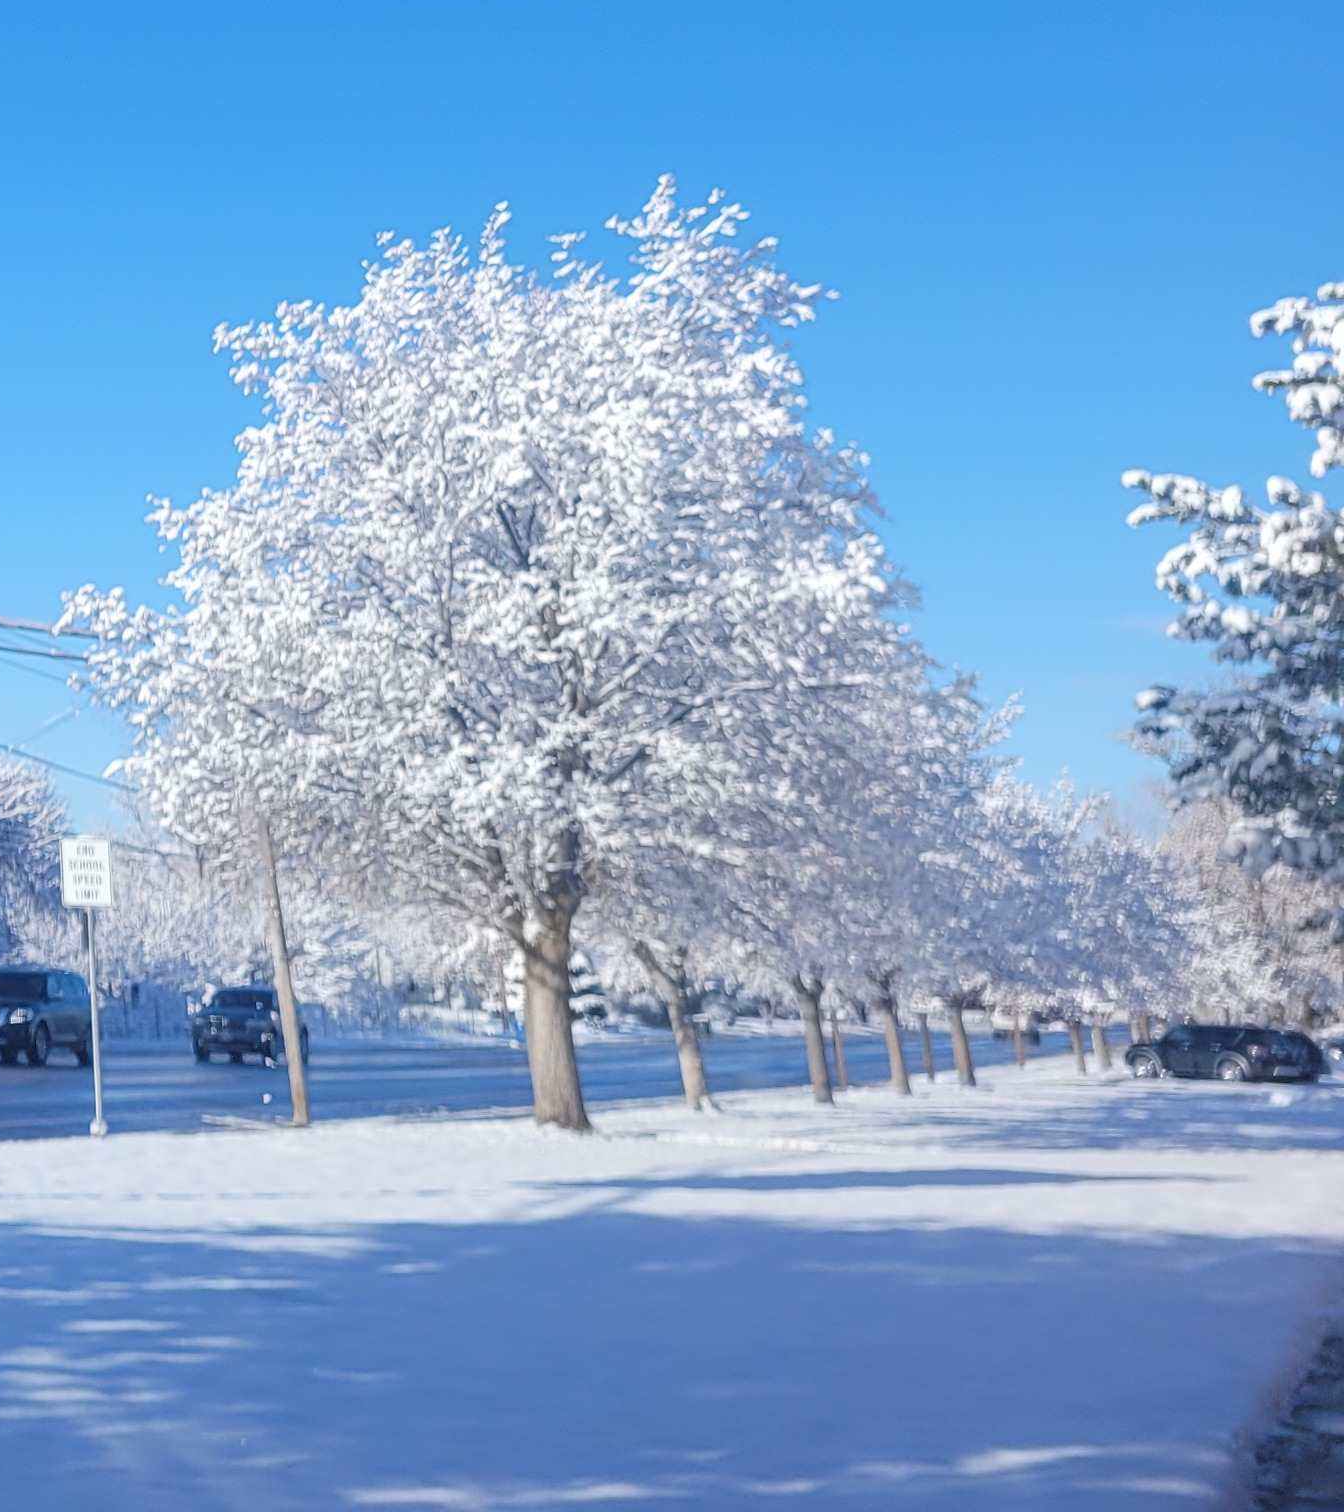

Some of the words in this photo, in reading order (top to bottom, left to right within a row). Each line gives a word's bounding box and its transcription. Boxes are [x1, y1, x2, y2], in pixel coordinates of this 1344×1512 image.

[68, 859, 104, 871] SCHOOL
[73, 874, 102, 886] SPEED
[75, 889, 99, 901] LIMIT
